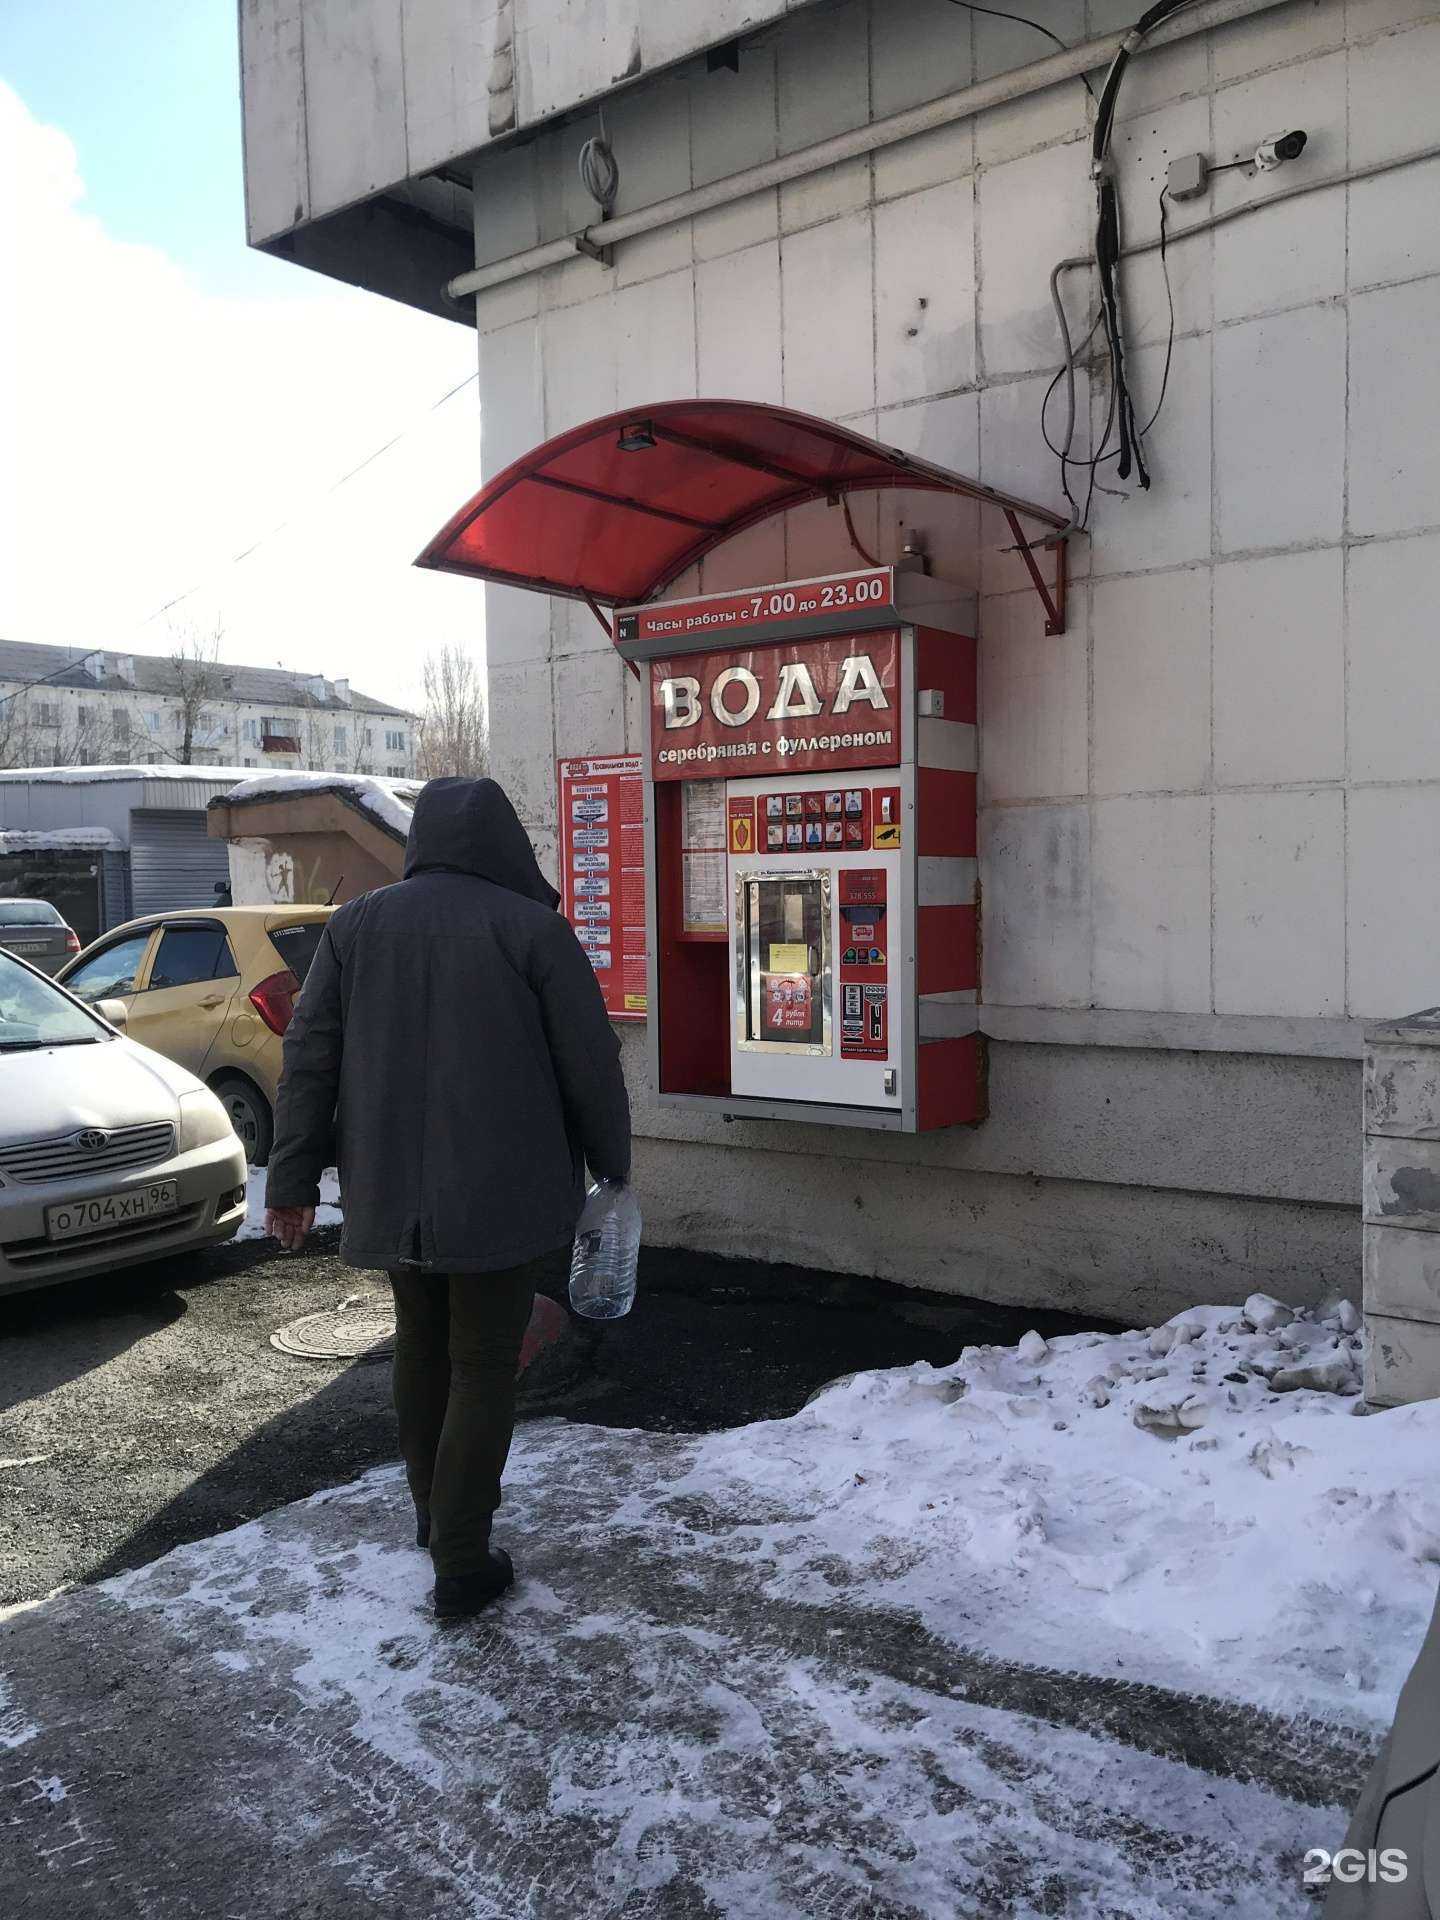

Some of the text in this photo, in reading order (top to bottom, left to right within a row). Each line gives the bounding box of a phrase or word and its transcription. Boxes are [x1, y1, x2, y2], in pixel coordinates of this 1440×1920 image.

[646, 578, 884, 632] Часы работы с 7.00 до 23.00
[660, 655, 889, 729] ВОДА
[658, 730, 892, 764] серебряная с фуллереном
[771, 1008, 784, 1026] 4
[150, 1185, 170, 1204] 96
